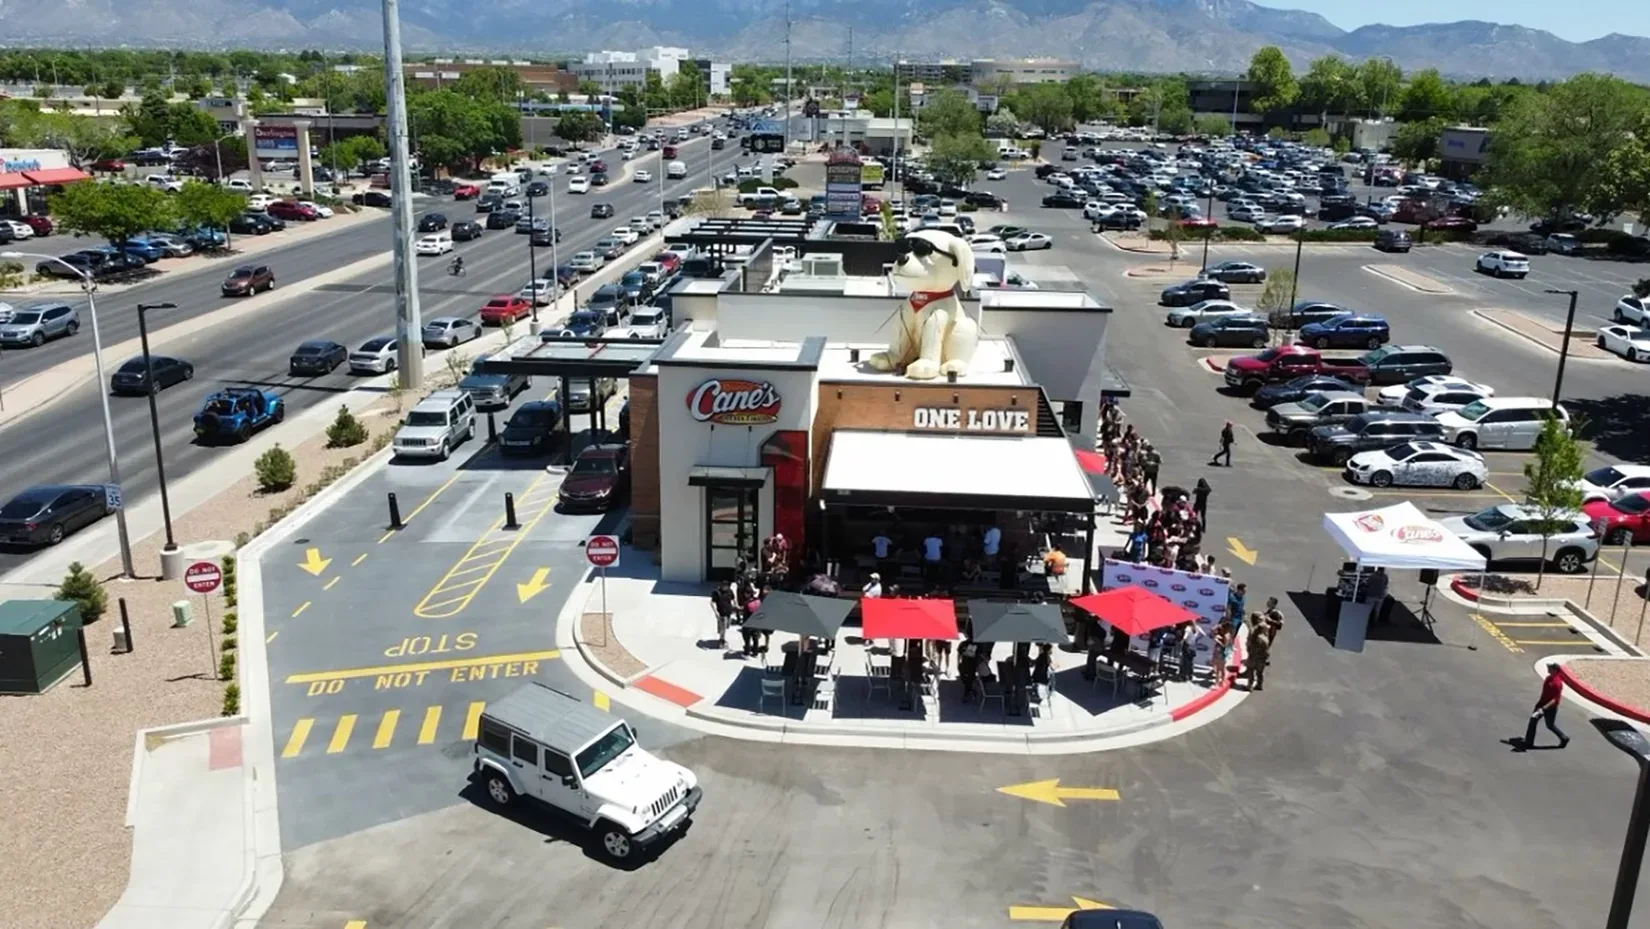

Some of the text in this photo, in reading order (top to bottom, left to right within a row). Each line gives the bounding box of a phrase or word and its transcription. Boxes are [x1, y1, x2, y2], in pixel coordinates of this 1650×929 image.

[691, 380, 780, 421] Cane's
[914, 408, 1029, 431] ONE LOVE
[108, 494, 121, 507] 35
[193, 581, 215, 589] ENTER
[384, 632, 479, 657] STOP
[307, 660, 540, 697] DO NOT ENTER
